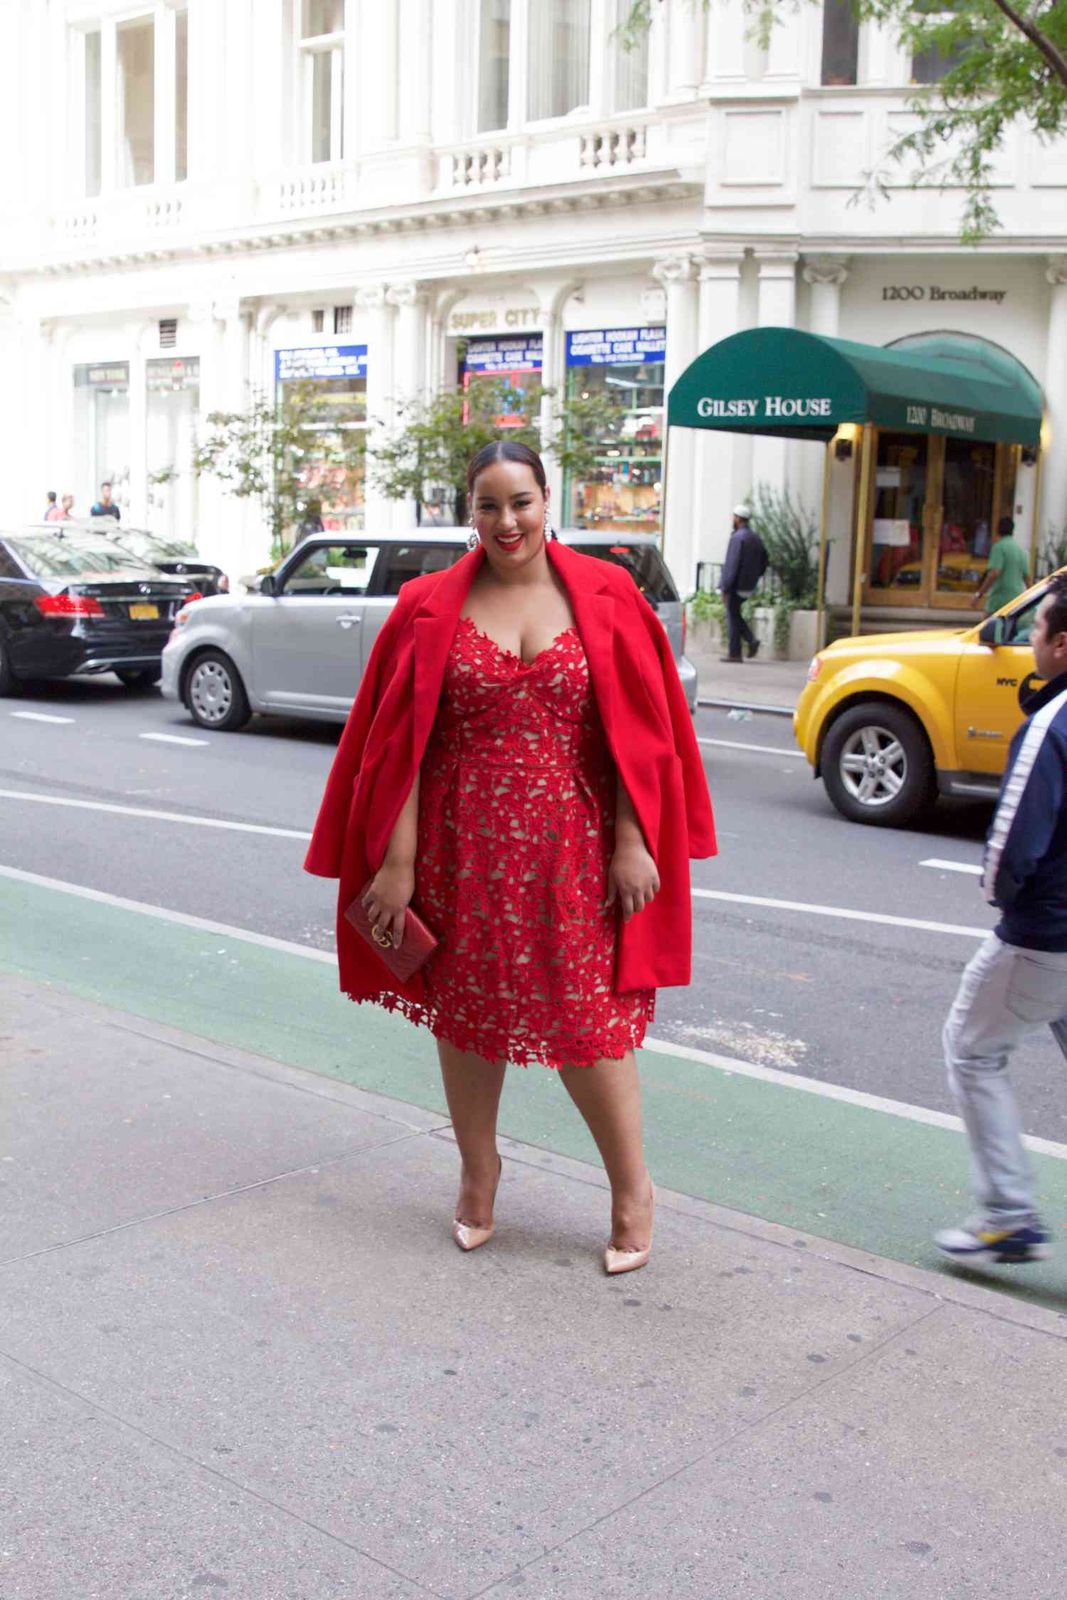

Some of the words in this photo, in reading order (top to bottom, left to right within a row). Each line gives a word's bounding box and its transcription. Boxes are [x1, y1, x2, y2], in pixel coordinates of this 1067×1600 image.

[882, 286, 924, 301] 1200
[929, 286, 1007, 305] Broadway
[451, 311, 497, 329] SUPER
[505, 307, 540, 327] CITY
[697, 397, 758, 417] GILSEY
[764, 396, 831, 416] HOUSE
[996, 678, 1017, 687] NYC
